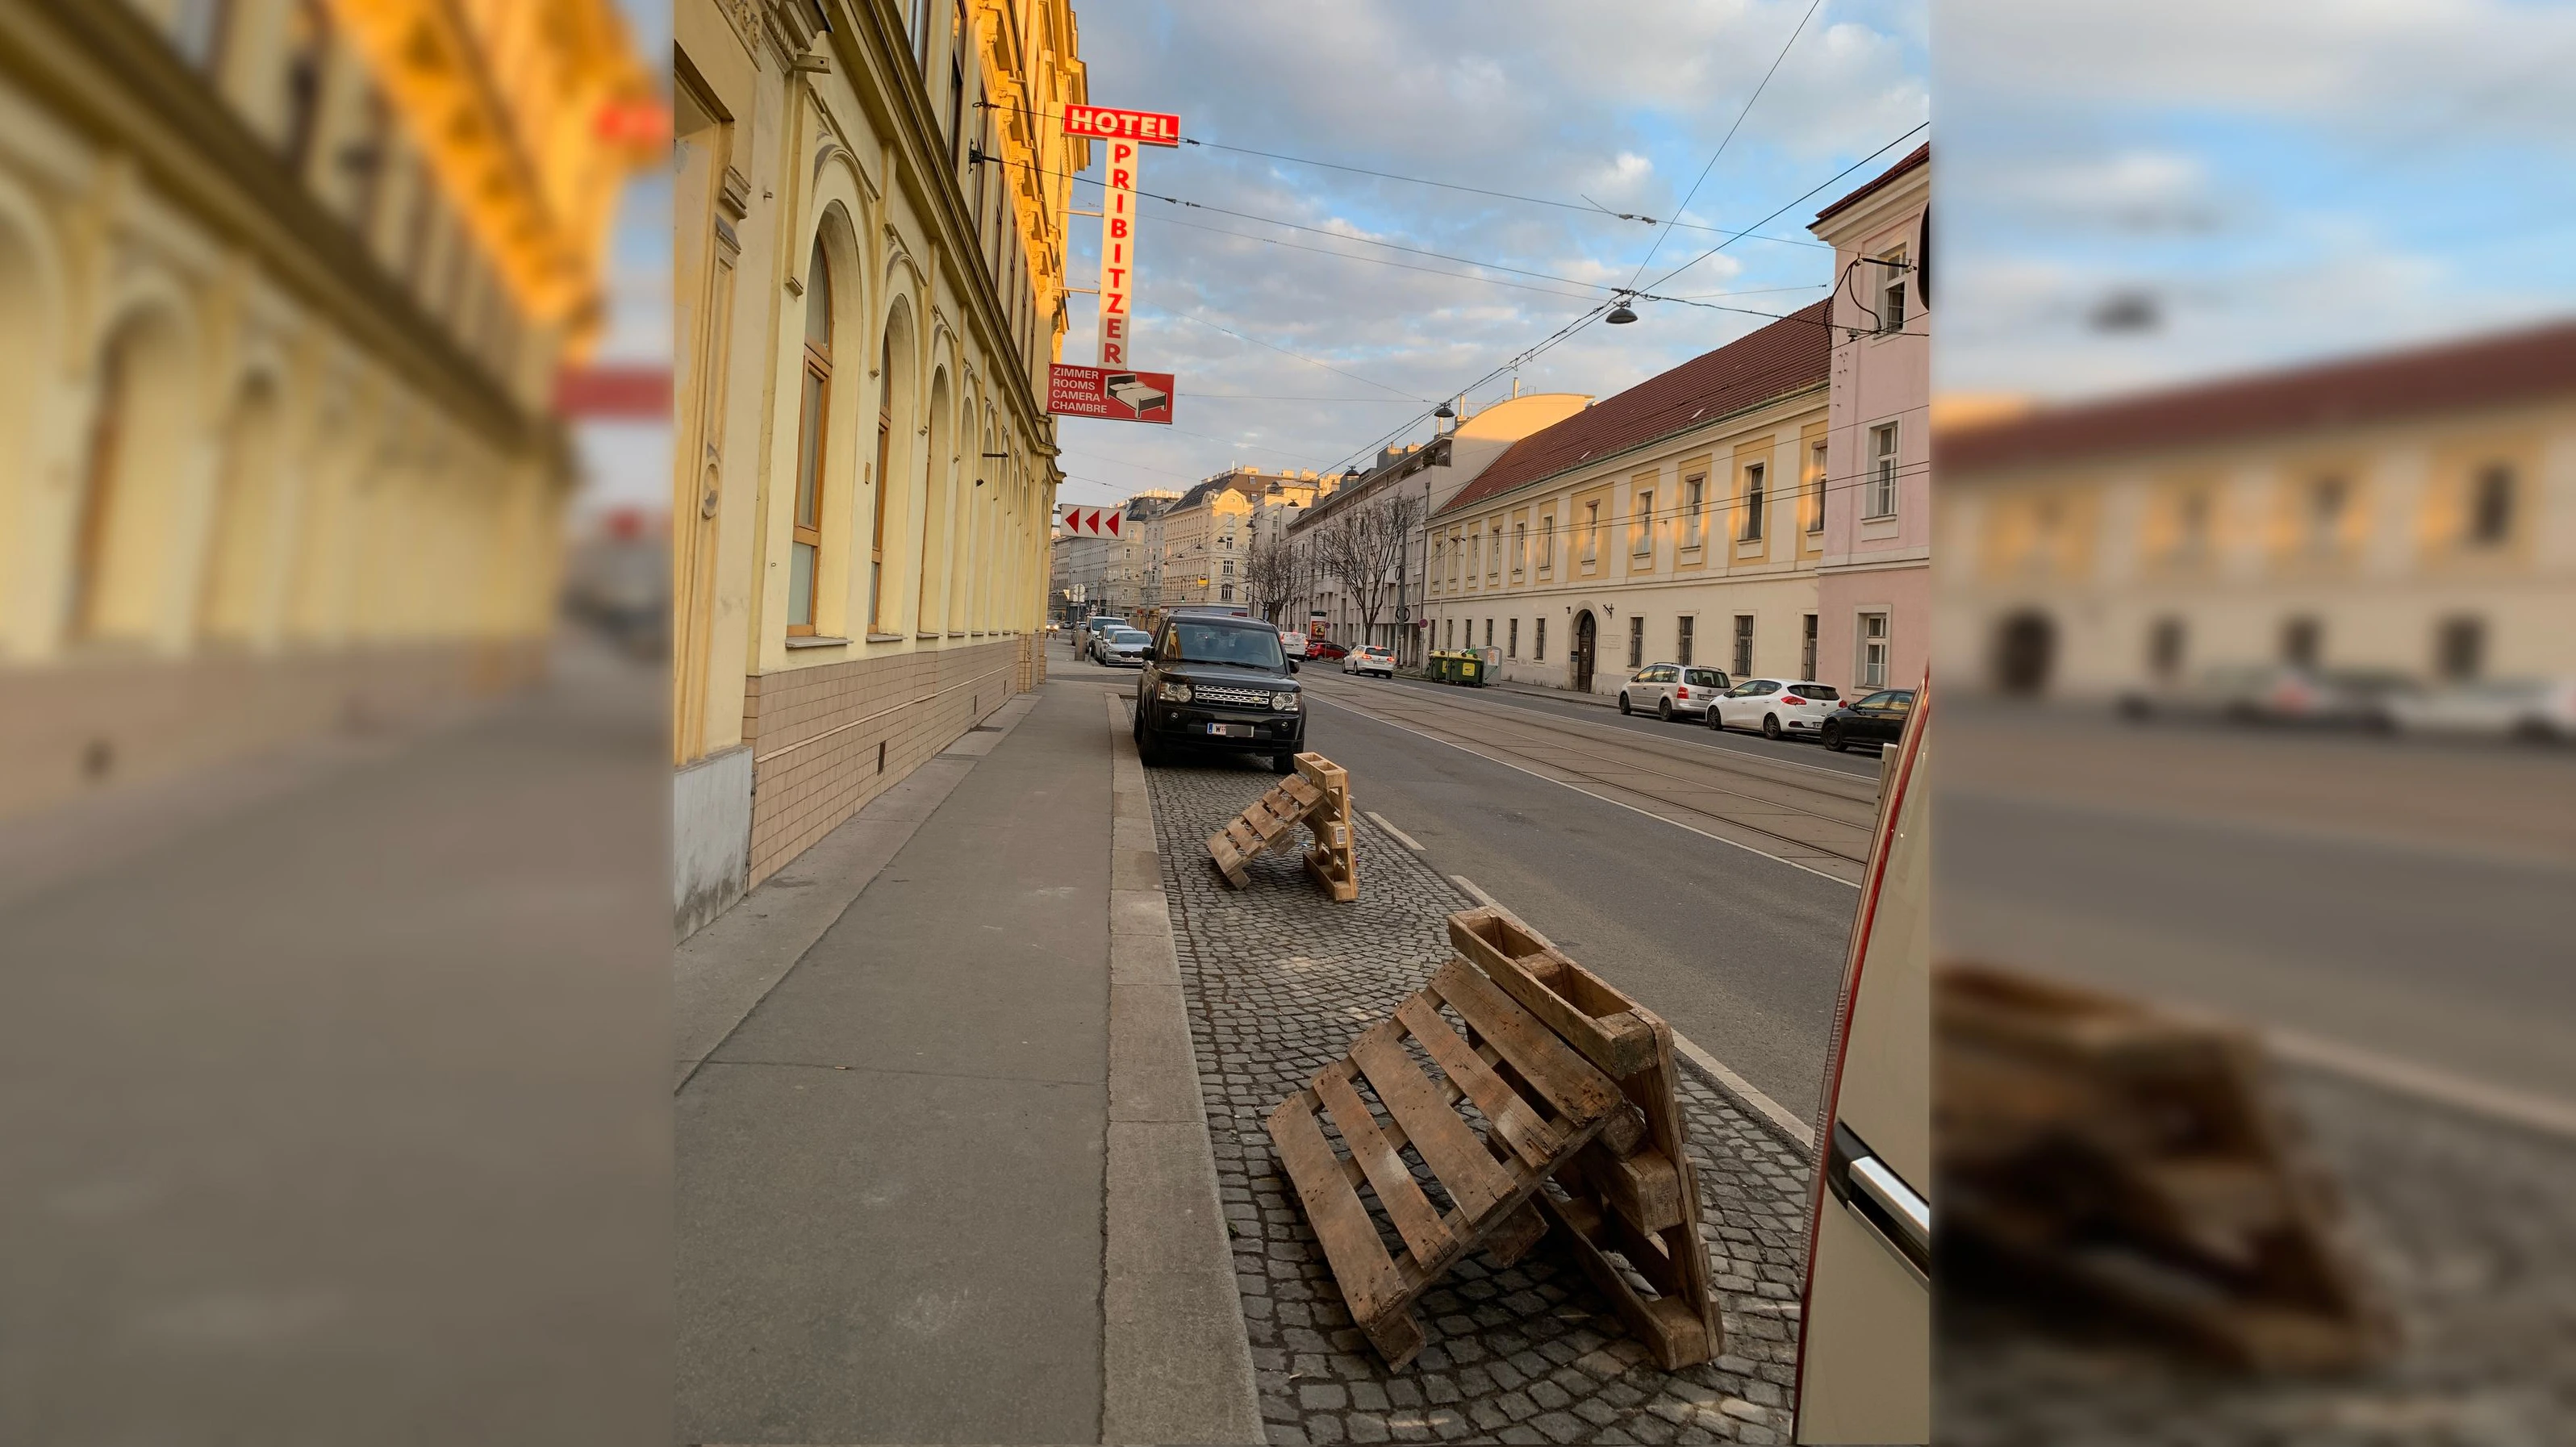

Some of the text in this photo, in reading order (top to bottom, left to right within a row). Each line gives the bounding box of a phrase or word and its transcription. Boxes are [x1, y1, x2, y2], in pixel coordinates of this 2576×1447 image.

[1071, 108, 1175, 139] HOTEL
[1104, 144, 1131, 365] PRIBITZER
[1054, 367, 1099, 380] ZIMMER
[1053, 379, 1096, 390] ROOMS
[1052, 390, 1100, 402] CAMERA
[1051, 400, 1108, 414] CHAMBRE
